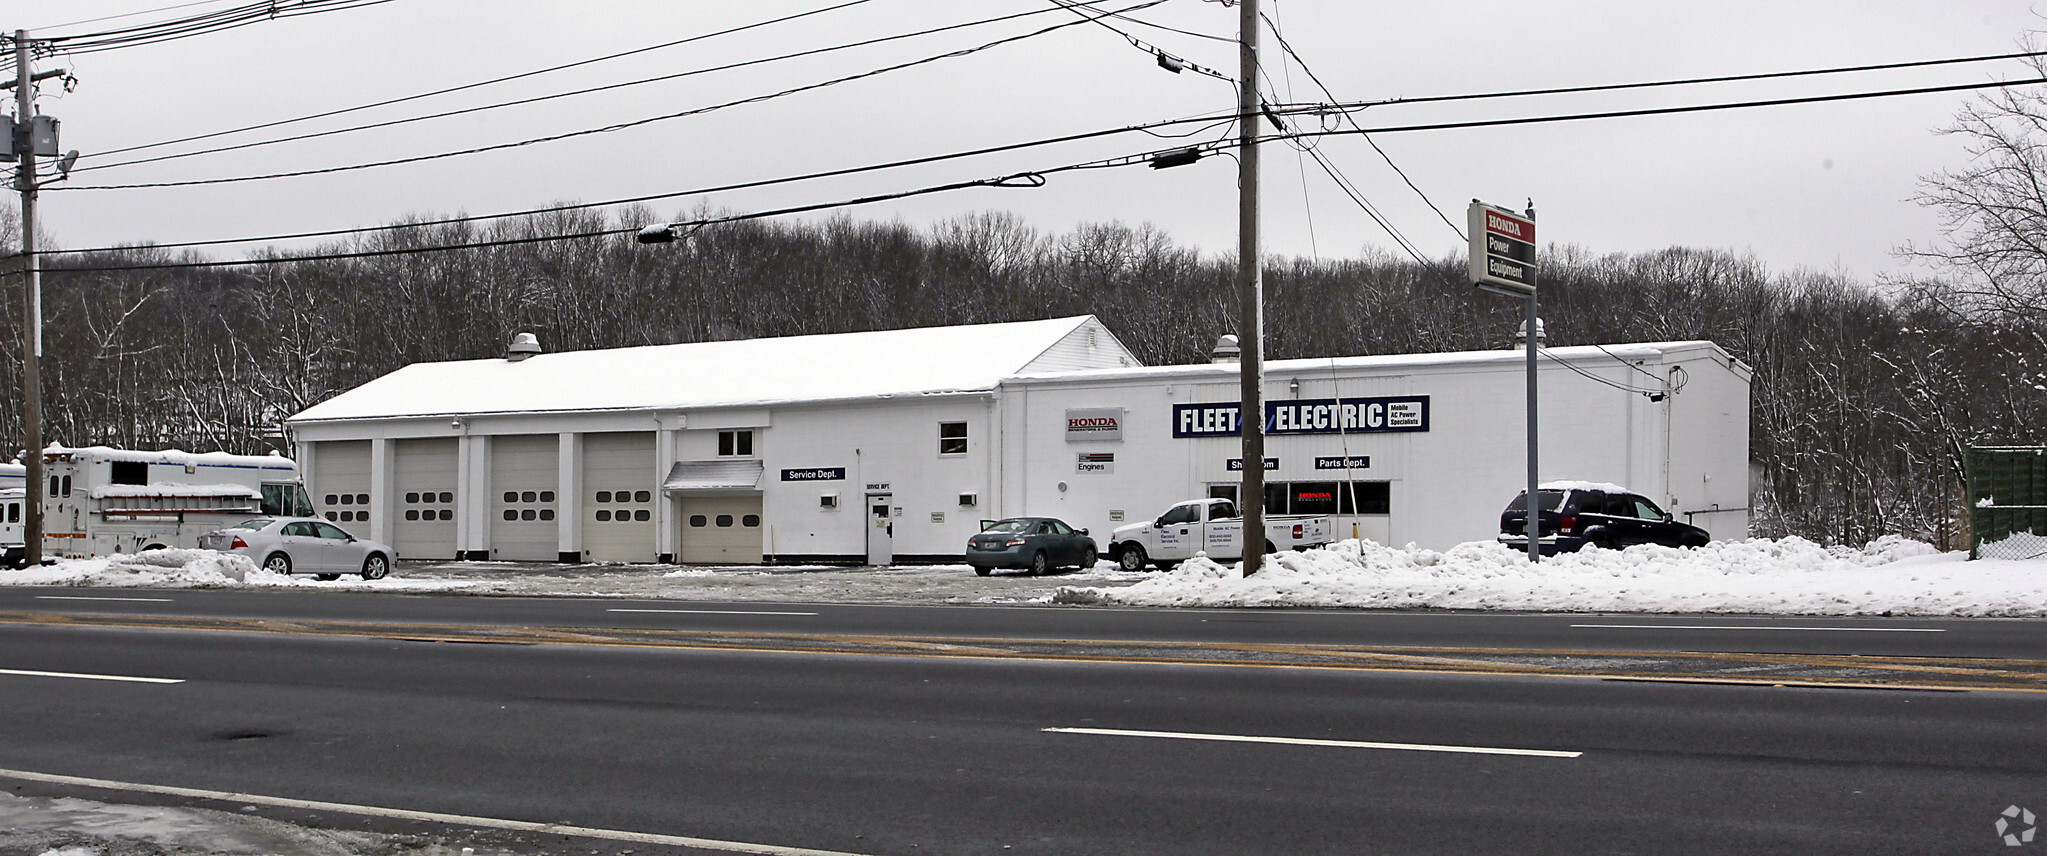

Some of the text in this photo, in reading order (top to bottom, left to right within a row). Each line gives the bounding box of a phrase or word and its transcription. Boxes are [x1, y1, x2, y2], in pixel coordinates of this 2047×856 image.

[1488, 215, 1521, 236] HONDA
[1489, 236, 1509, 253] Power
[1490, 258, 1523, 279] Equipment
[1068, 417, 1118, 427] HONDA
[1180, 403, 1383, 433] FLEET ELECTRIC
[1390, 418, 1419, 426] Specialists
[1078, 463, 1105, 471] Engines
[1319, 458, 1366, 469] Parts Dept.
[789, 469, 837, 480] Service Dept.
